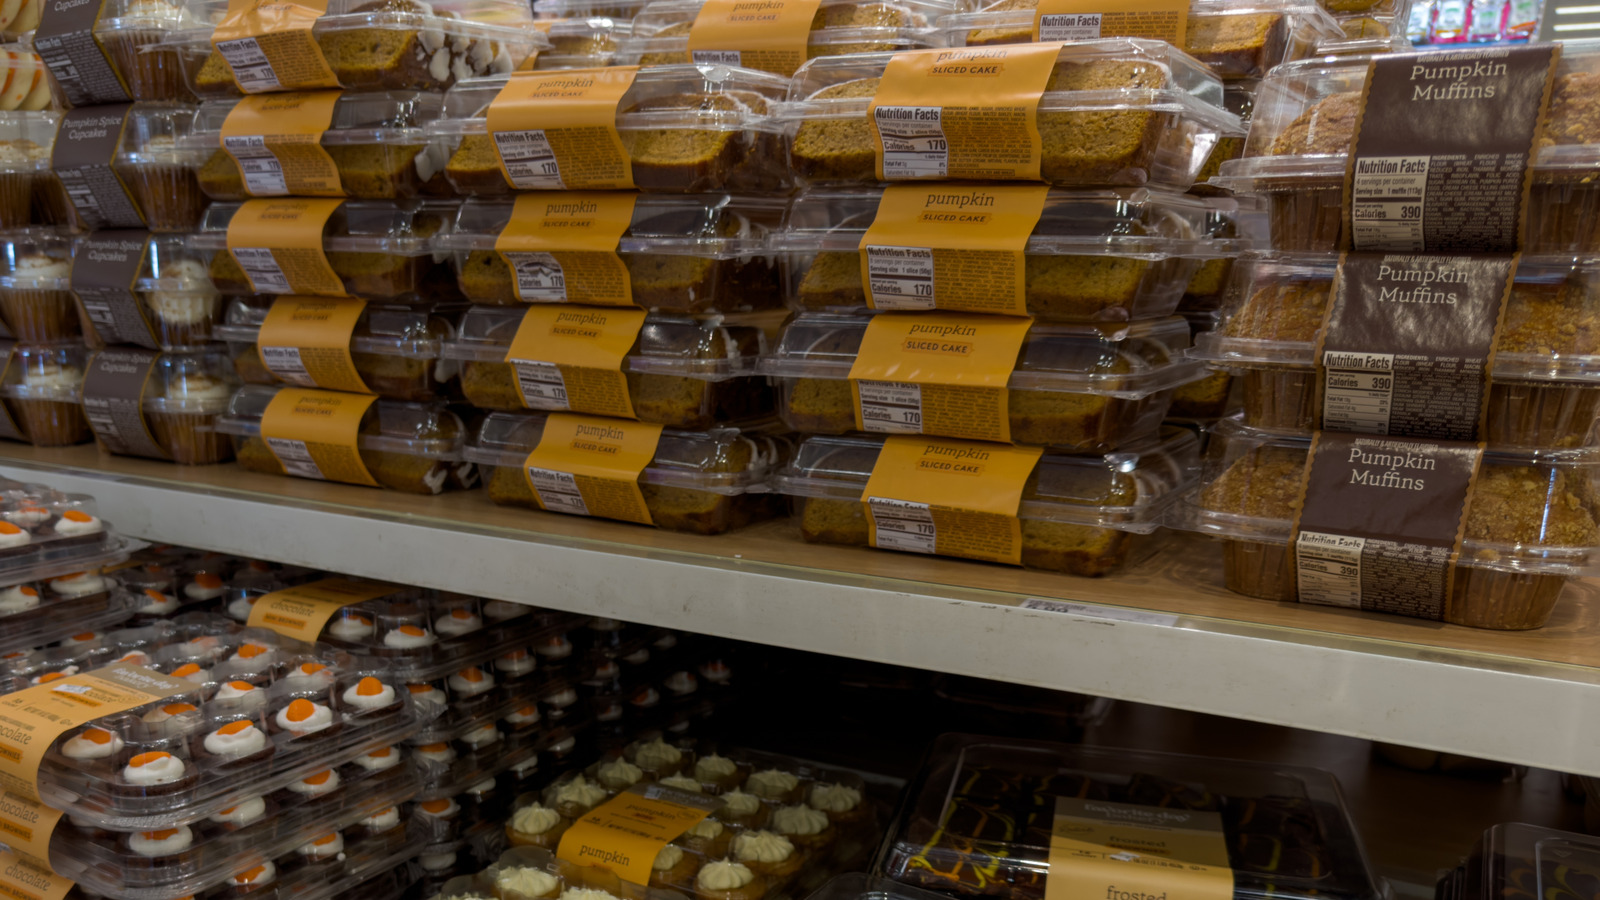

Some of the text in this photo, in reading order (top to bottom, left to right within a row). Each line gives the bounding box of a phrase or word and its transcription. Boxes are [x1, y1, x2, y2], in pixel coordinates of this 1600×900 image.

[734, 1, 784, 12] pumpkin
[1041, 15, 1100, 27] Nutrition Facts
[694, 52, 721, 63] Nutrition
[721, 52, 739, 62] Facts
[937, 48, 1008, 62] pumpkin
[933, 66, 998, 74] SLICED CAKE
[1409, 60, 1508, 82] Pumpkin
[537, 78, 594, 91] pumpkin
[1411, 81, 1496, 101] Muffins
[876, 107, 939, 121] Nutrition Facts
[62, 117, 98, 130] Pumpkin
[68, 128, 108, 141] Cupcakes
[495, 131, 546, 144] Nutrition Facts
[884, 139, 946, 151] Calories 170
[541, 162, 557, 174] 170
[1358, 158, 1426, 175] Nutrition Facts
[1361, 178, 1382, 187] servings
[1356, 188, 1373, 196] Serving
[925, 192, 995, 209] pumpkin
[545, 200, 597, 216] pumpkin
[1355, 205, 1421, 219] Calories 390
[922, 214, 986, 223] SLICED CAKE
[867, 247, 931, 259] Nutrition Facts
[550, 275, 564, 287] 170
[1376, 265, 1469, 286] Pumpkin
[871, 283, 932, 297] Calories 170
[1378, 286, 1458, 305] Muffins
[556, 312, 607, 325] pumpkin
[909, 323, 977, 338] pumpkin
[906, 341, 969, 355] SLICED CAKE
[1326, 353, 1391, 370] Nutrition Facts
[1328, 376, 1391, 390] Calories 390
[552, 388, 566, 399] 170
[863, 409, 921, 423] Calories 170
[575, 423, 624, 440] pumpkin
[924, 444, 990, 461] pumpkin
[1347, 447, 1437, 472] Pumpkin
[920, 460, 980, 474] SLICED CAKE
[1349, 469, 1425, 491] Muffins
[877, 521, 935, 535] Calories 170
[1301, 532, 1336, 546] Nutrition
[1299, 561, 1359, 577] Calories 390
[270, 601, 316, 618] chocolate
[579, 843, 632, 868] pumpkin
[4, 863, 52, 892] chocolate
